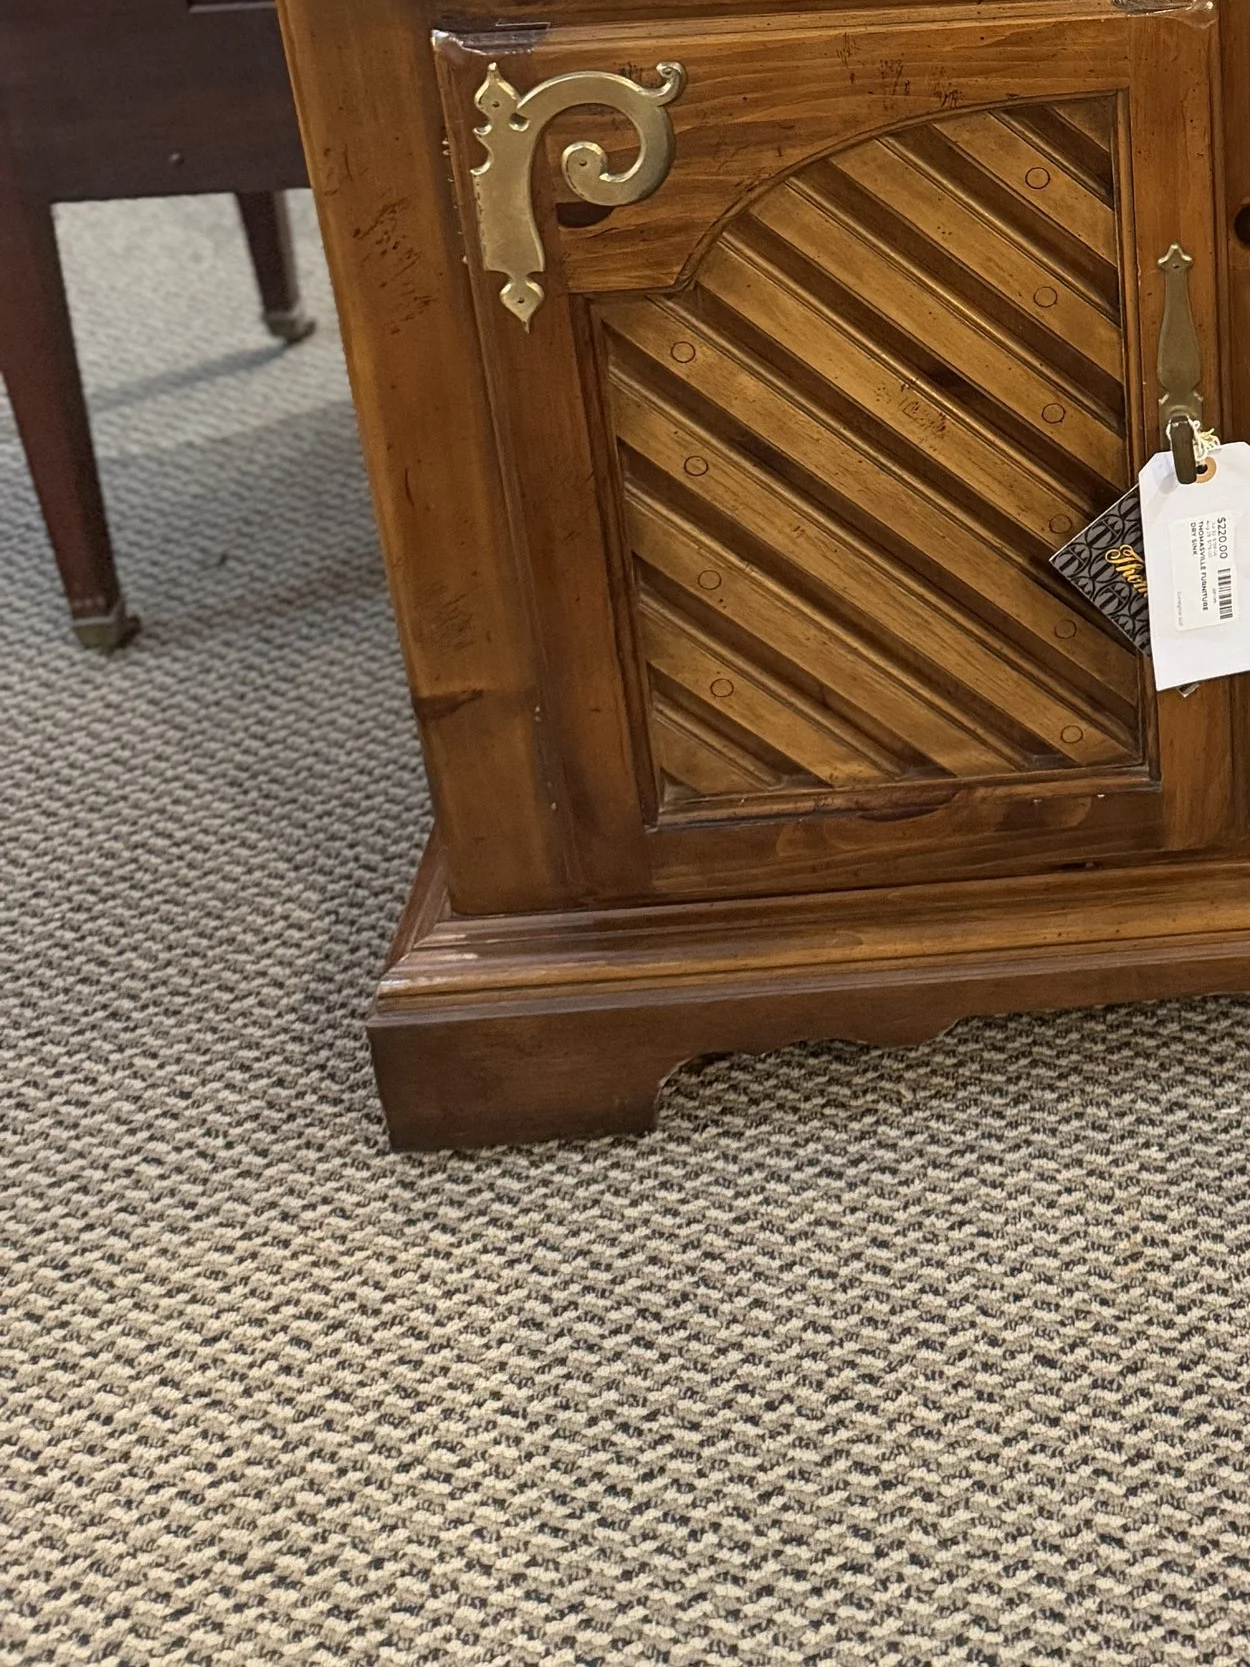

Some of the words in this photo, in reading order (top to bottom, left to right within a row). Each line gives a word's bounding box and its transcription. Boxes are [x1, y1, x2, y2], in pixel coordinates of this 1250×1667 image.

[1198, 520, 1206, 571] THOMASVILLE
[1217, 517, 1228, 560] $220.00
[1200, 572, 1209, 612] FURNITURE
